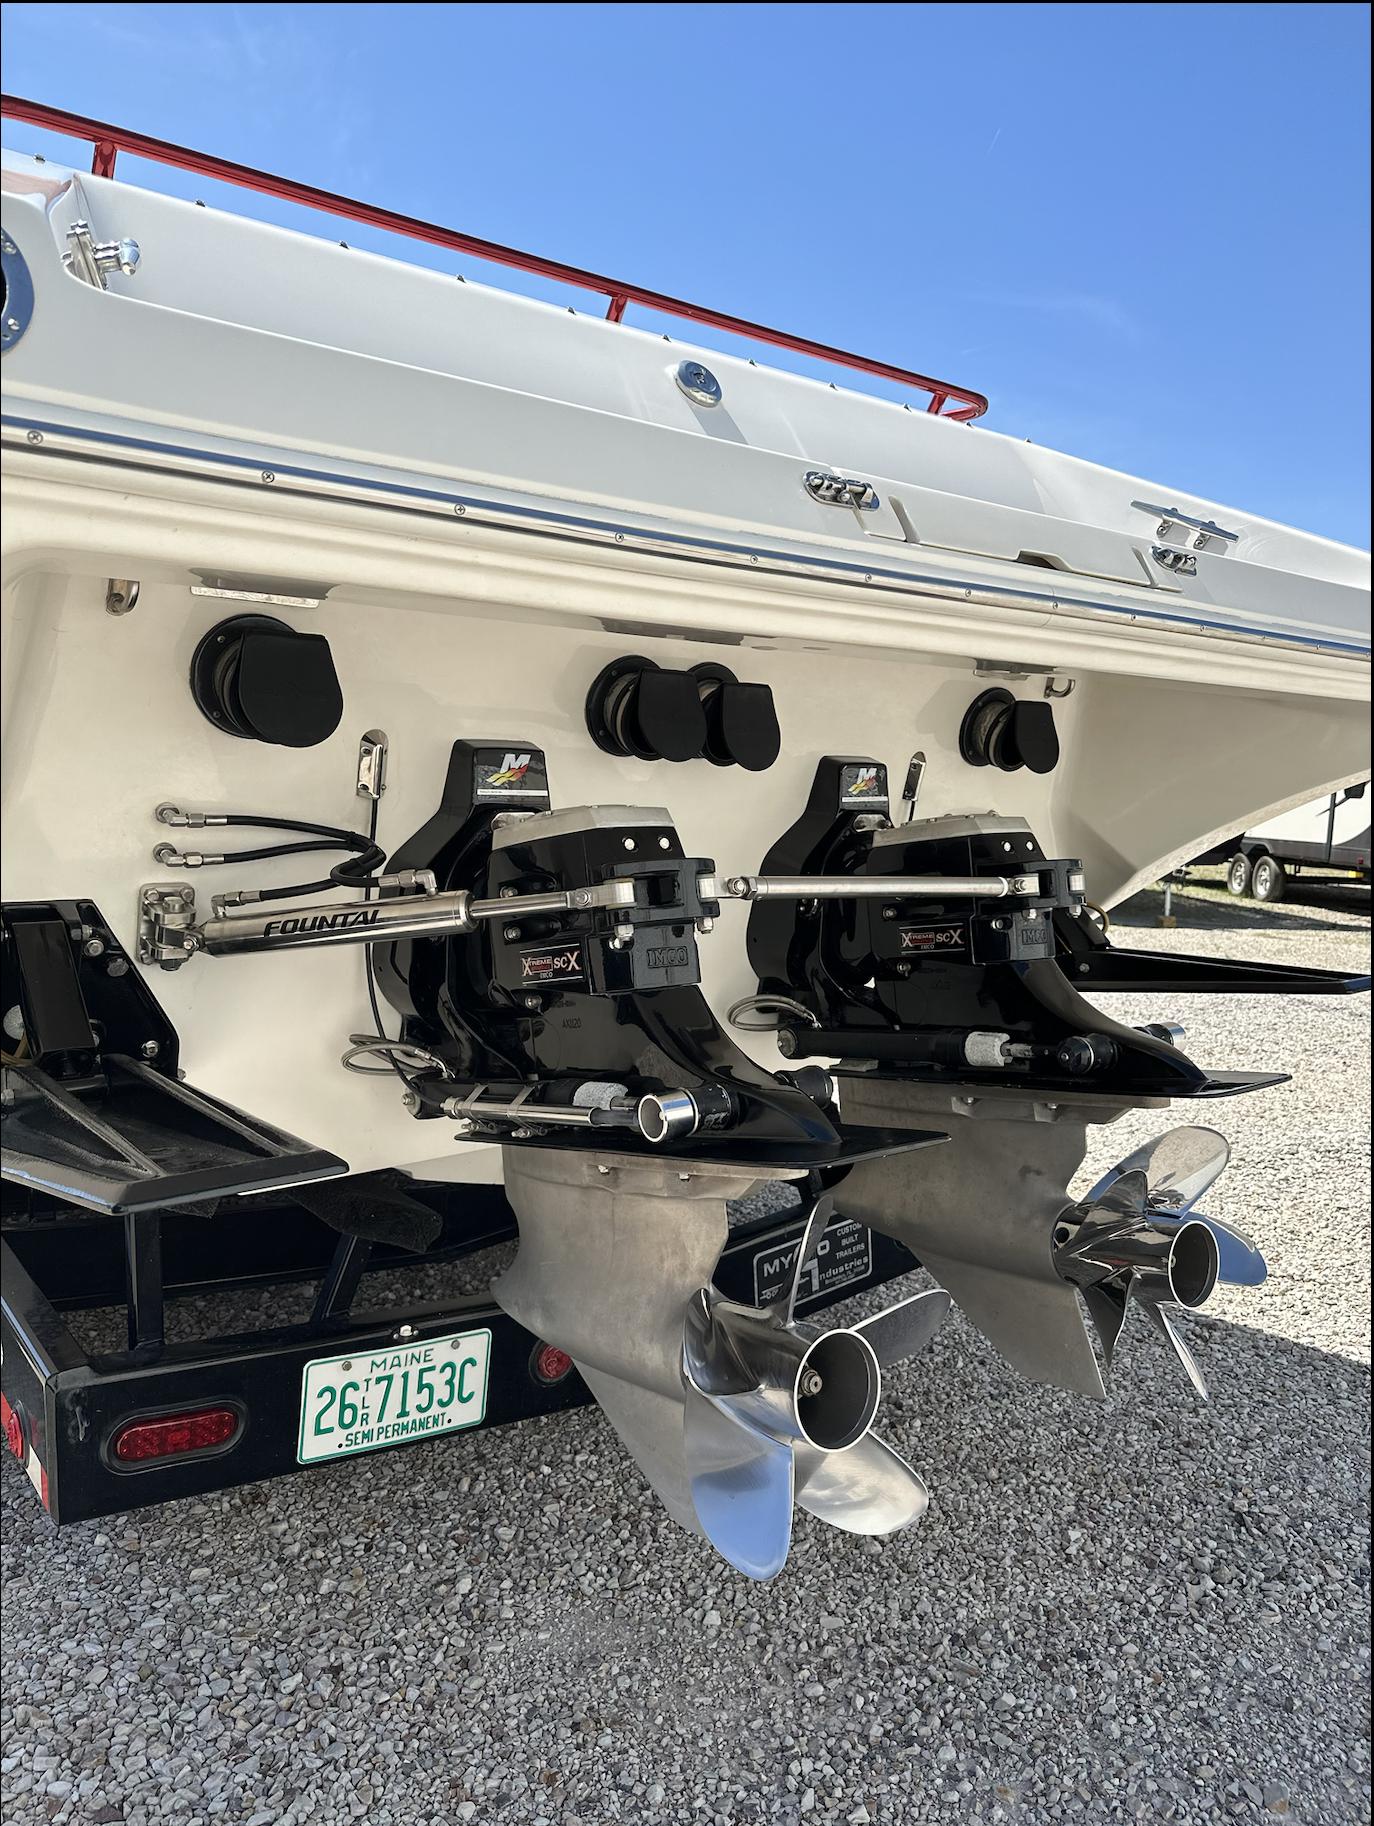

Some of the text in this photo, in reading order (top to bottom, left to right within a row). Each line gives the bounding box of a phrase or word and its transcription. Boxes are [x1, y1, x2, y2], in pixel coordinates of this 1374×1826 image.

[647, 947, 688, 968] IMCO
[835, 1242, 865, 1259] TRAILERS
[841, 1233, 858, 1246] BUILT
[763, 1239, 830, 1277] MYO
[370, 1348, 434, 1373] MAINE
[345, 1412, 447, 1447] SEMI PERMANENT
